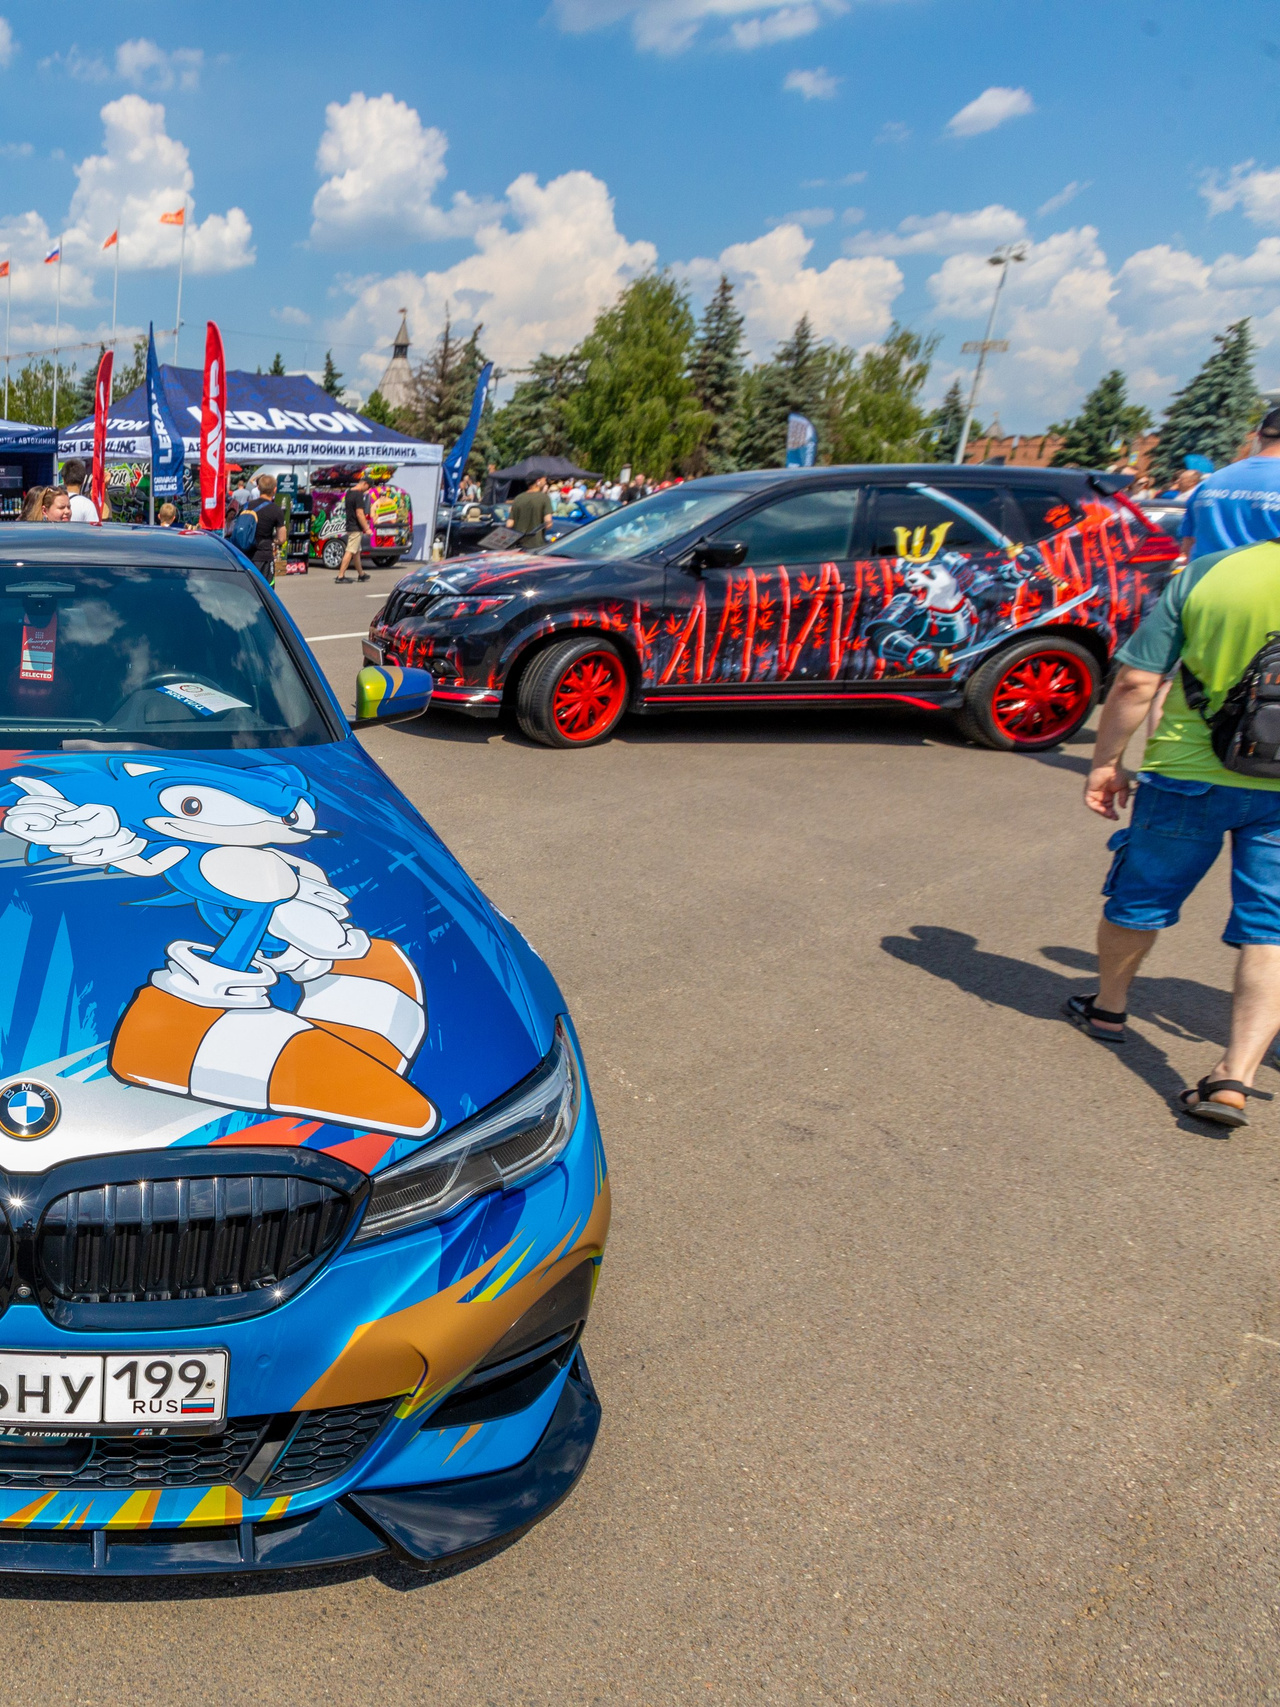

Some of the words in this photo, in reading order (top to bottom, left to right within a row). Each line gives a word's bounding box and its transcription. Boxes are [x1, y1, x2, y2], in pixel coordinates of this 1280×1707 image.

[19, 437, 56, 445] АВТОХИМИЯ
[287, 443, 309, 455] ДЛЯ
[311, 442, 346, 456] МОЙКИ
[349, 445, 355, 456] И
[358, 443, 417, 457] ДЕТЕЙЛИНГА
[21, 671, 52, 679] SELECTED
[2, 1083, 52, 1100] BMW
[112, 1359, 208, 1399] 199
[132, 1399, 179, 1414] RUS
[24, 1430, 92, 1438] AUTOMOBILE
